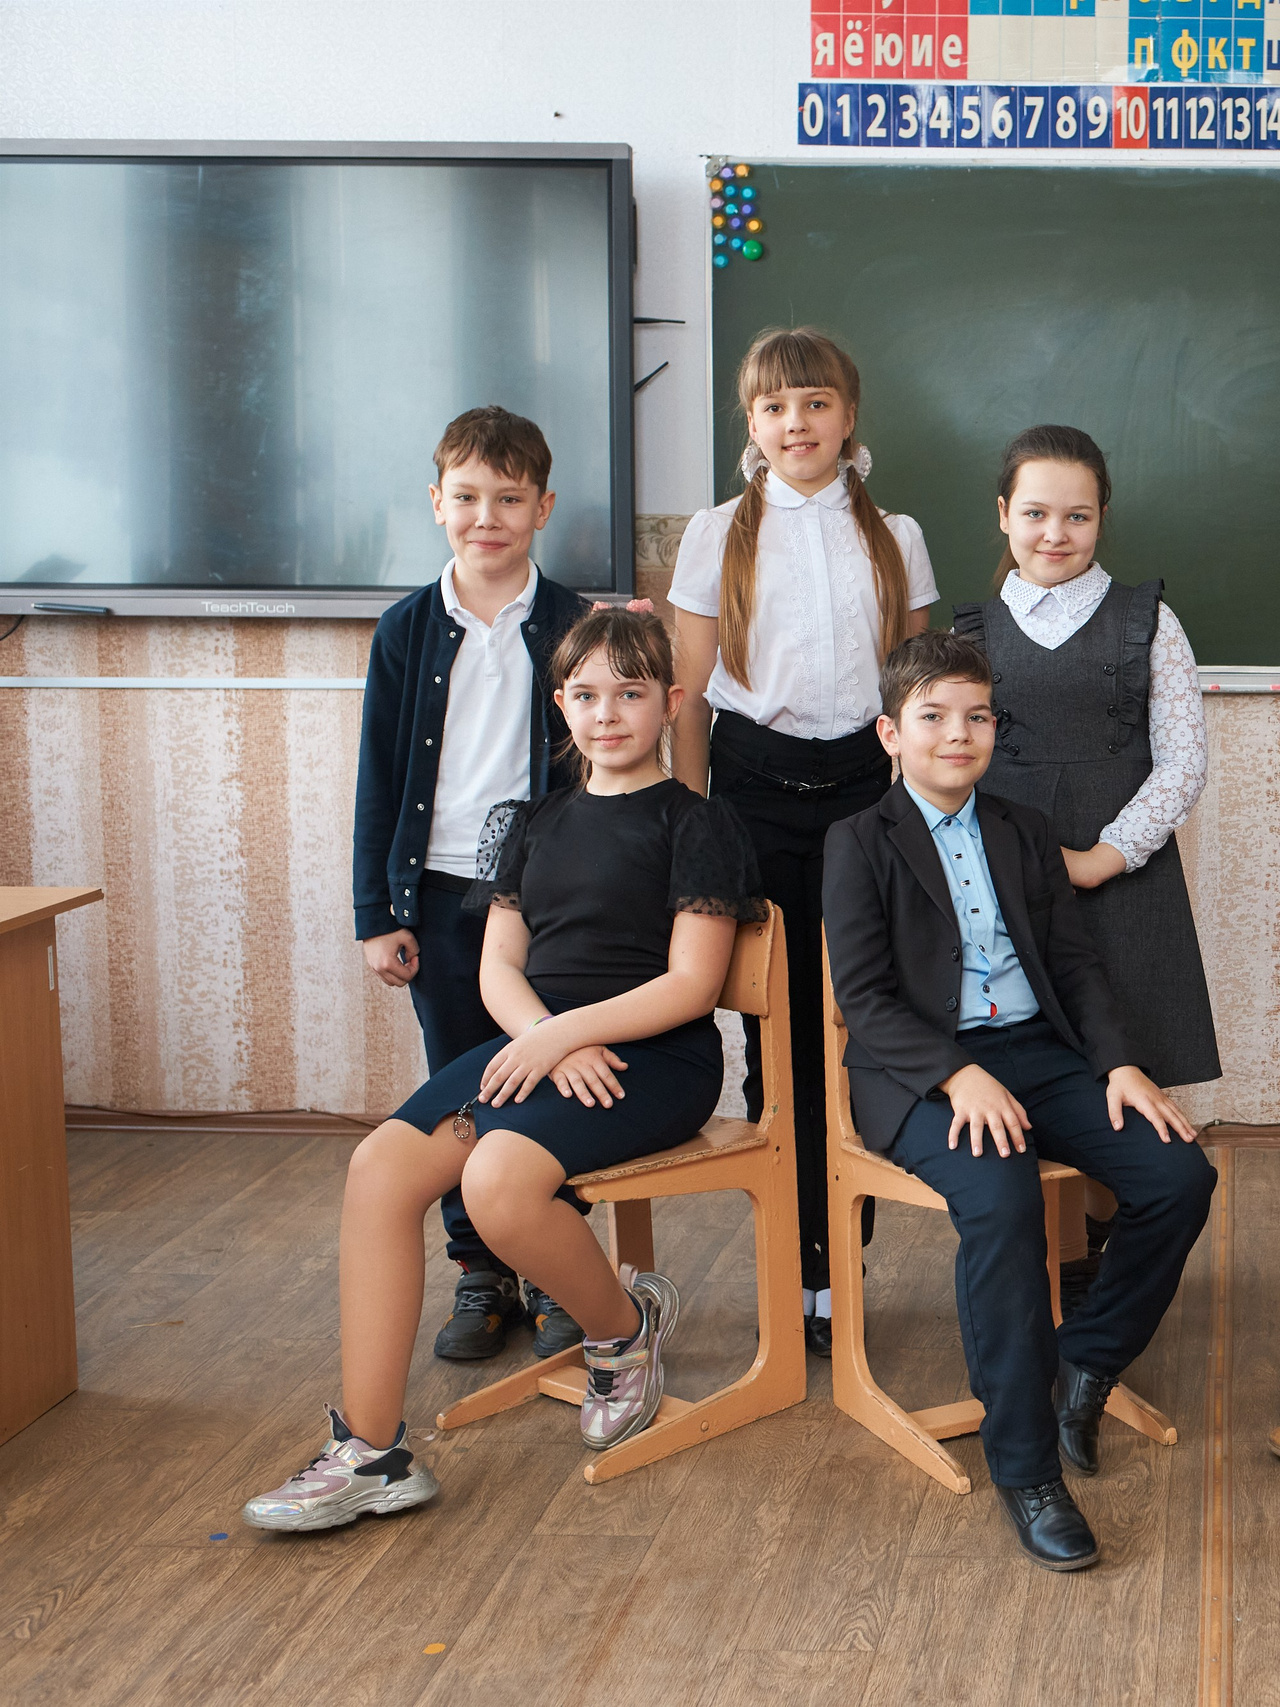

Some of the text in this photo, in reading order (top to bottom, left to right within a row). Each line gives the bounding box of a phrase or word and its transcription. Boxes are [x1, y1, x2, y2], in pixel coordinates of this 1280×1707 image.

[803, 94, 824, 137] 0
[836, 94, 850, 137] 1
[866, 94, 886, 138] 2
[898, 95, 918, 139] 3
[929, 96, 951, 138] 4
[961, 96, 981, 139] 5
[992, 96, 1013, 139] 6
[1024, 96, 1044, 139] 7
[1056, 96, 1077, 140] 8
[1086, 96, 1108, 140] 9
[1116, 96, 1146, 140] 10
[1152, 98, 1178, 140] 11
[1186, 98, 1216, 140] 12
[1221, 98, 1250, 140] 13
[201, 601, 295, 613] TeachTouch
